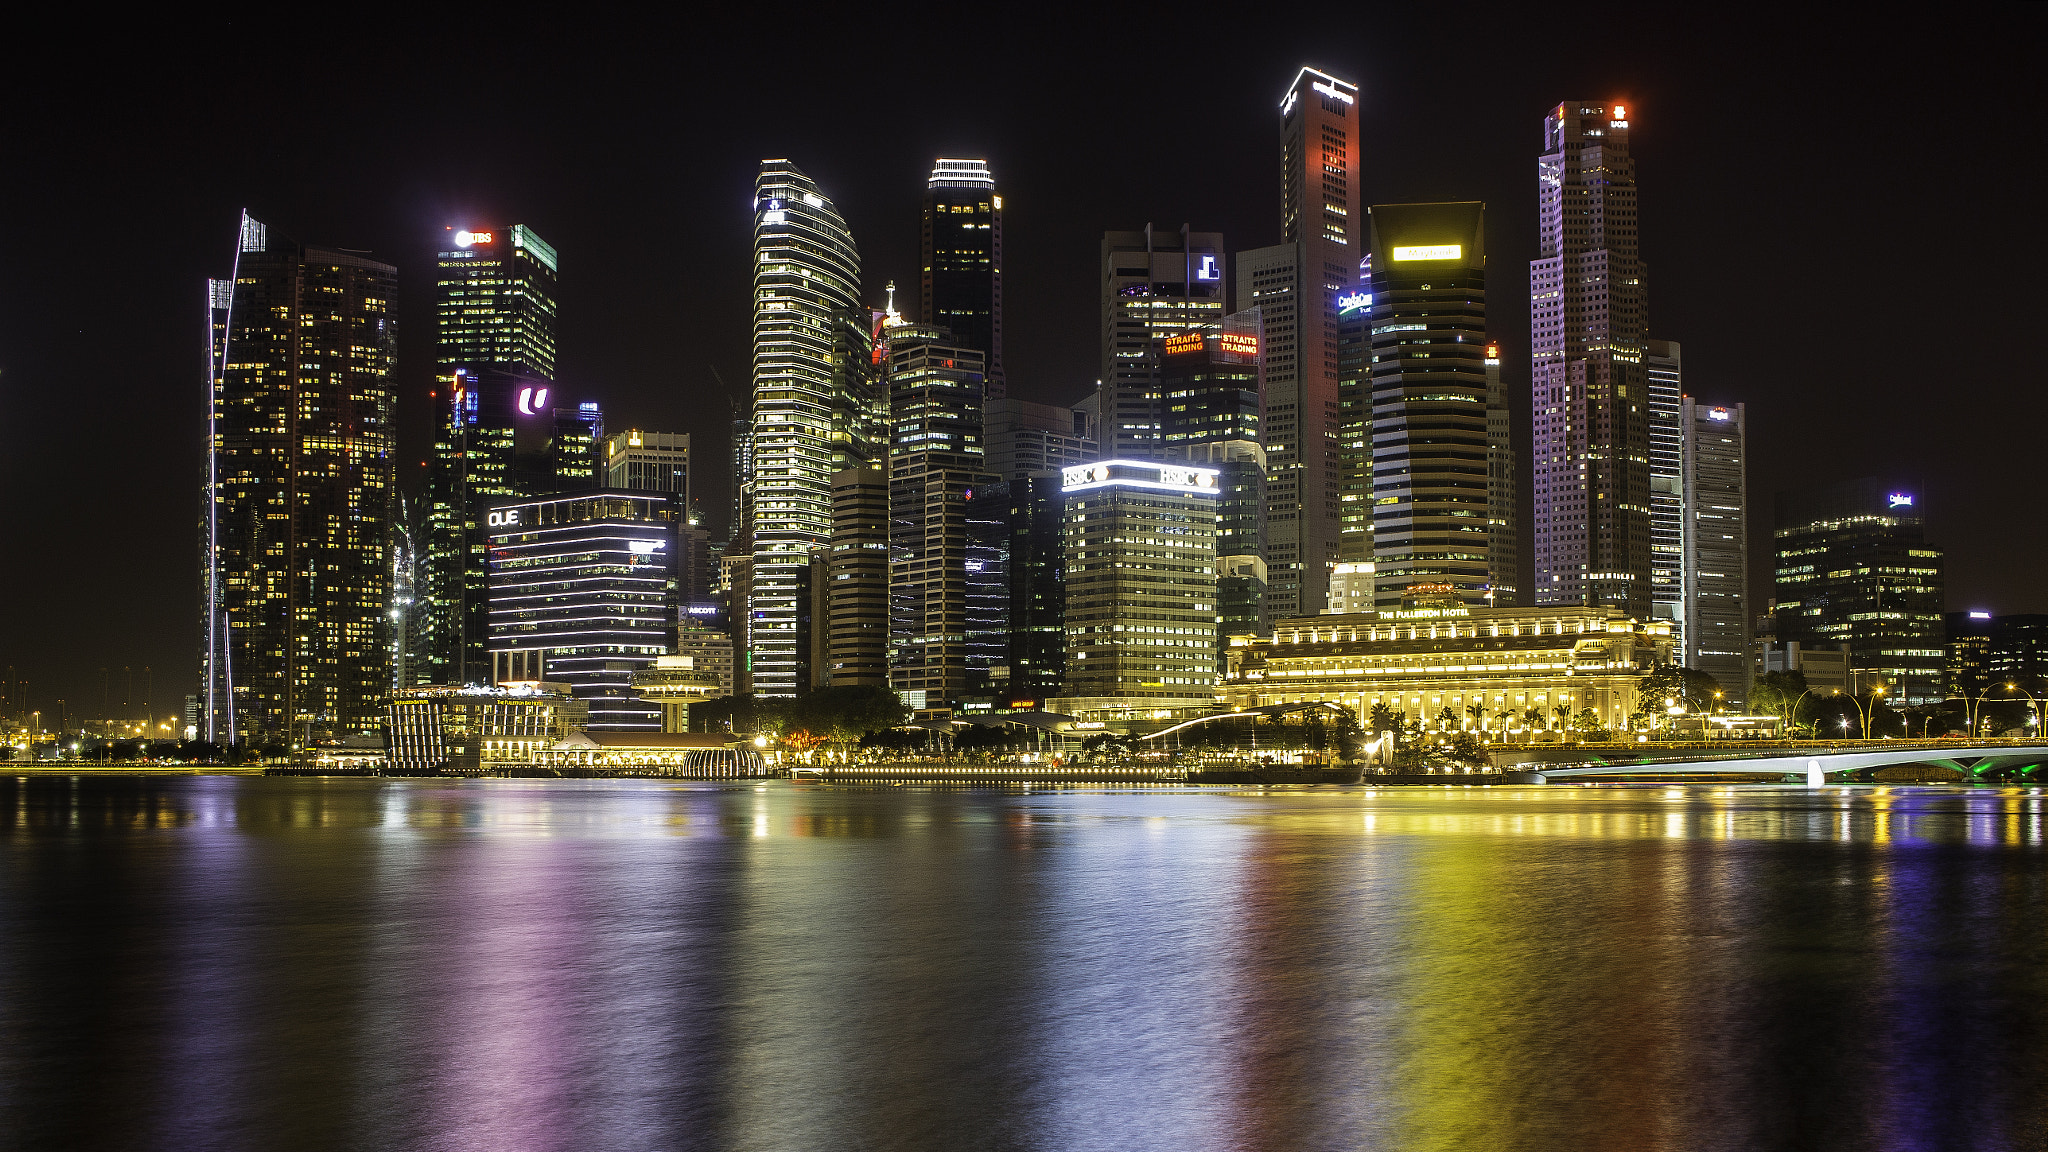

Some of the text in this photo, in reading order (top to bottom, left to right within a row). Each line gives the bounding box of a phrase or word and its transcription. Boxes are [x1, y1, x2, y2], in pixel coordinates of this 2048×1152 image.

[1166, 333, 1201, 346] STRAITS
[1223, 334, 1257, 345] STRAITS
[1166, 342, 1203, 355] TRADING
[1221, 342, 1257, 354] TRADING
[1063, 467, 1094, 485] HSBC
[1160, 468, 1195, 486] HSBC
[488, 510, 519, 527] OUE
[1396, 610, 1441, 619] FULLERTON
[1442, 608, 1470, 617] HOTEL
